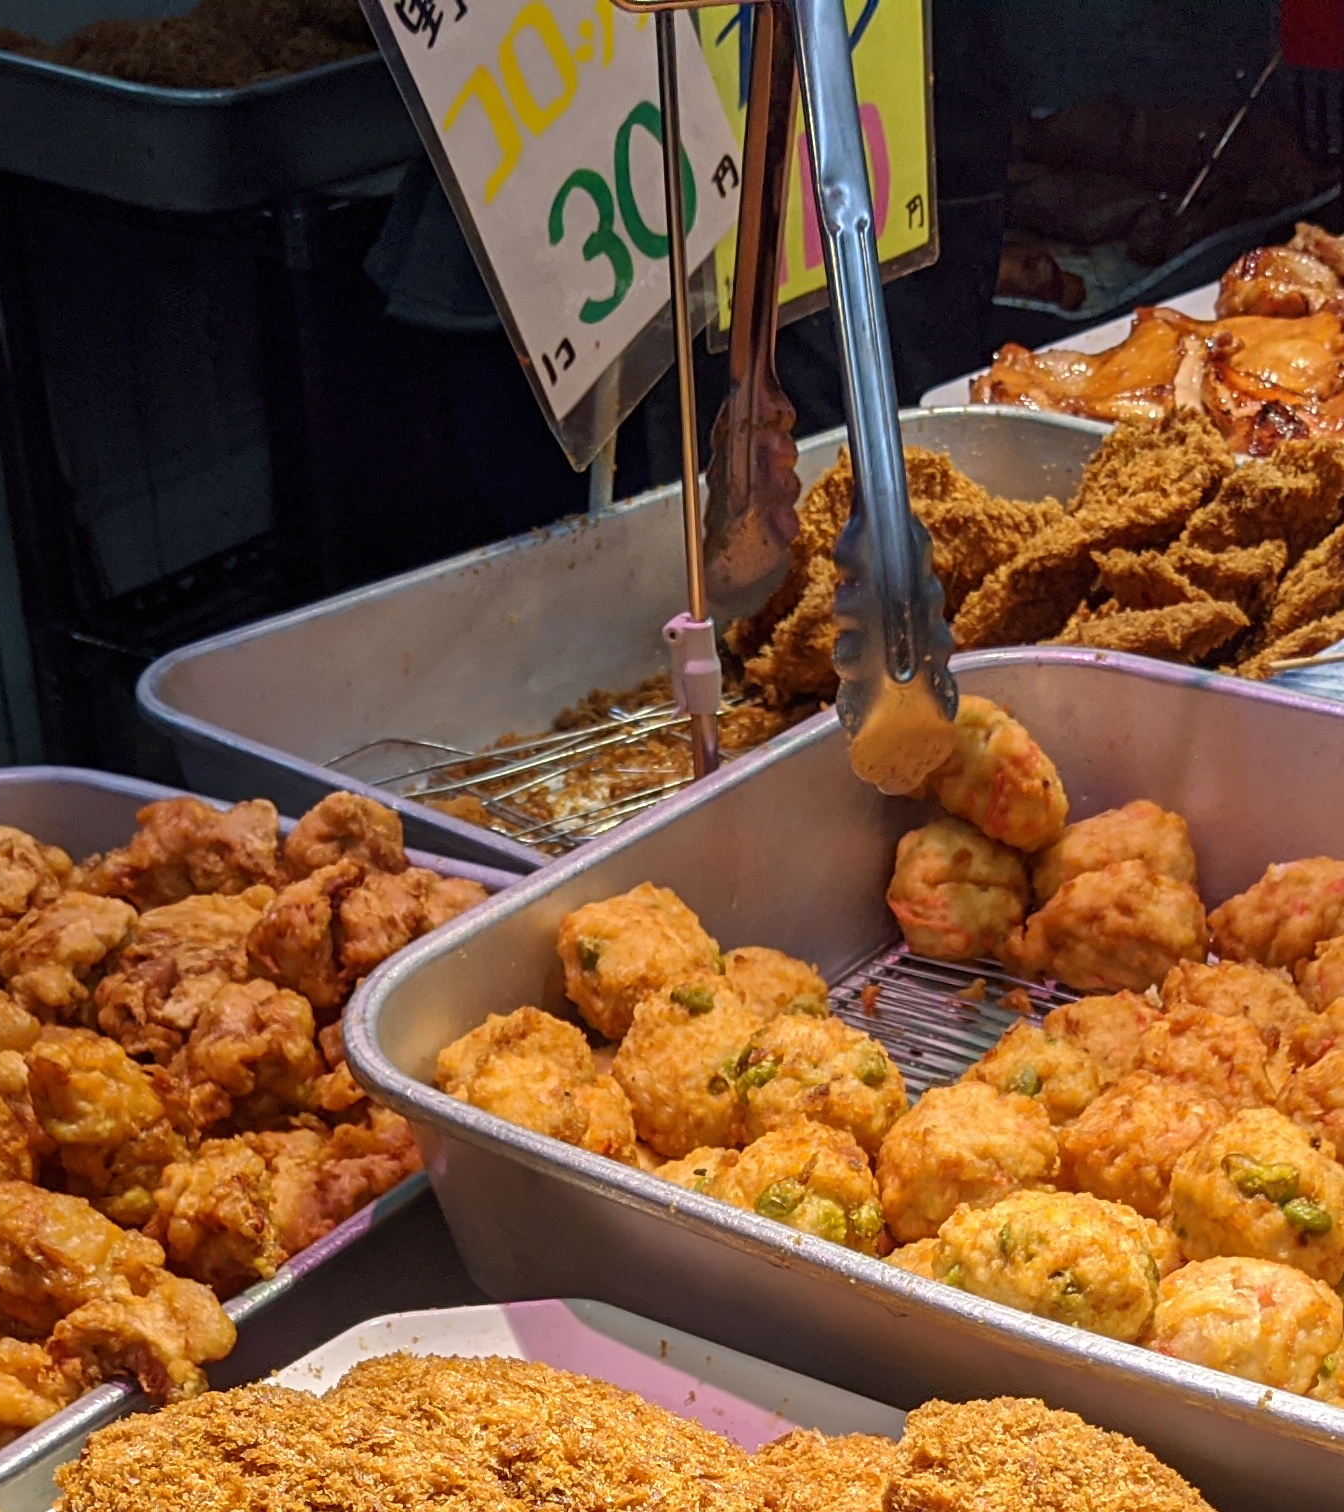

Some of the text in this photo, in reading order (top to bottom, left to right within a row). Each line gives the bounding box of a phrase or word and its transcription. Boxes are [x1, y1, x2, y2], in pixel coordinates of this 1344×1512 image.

[442, 0, 650, 207] コロッ
[548, 100, 698, 324] 30
[711, 154, 740, 199] 円
[905, 193, 925, 230] 円
